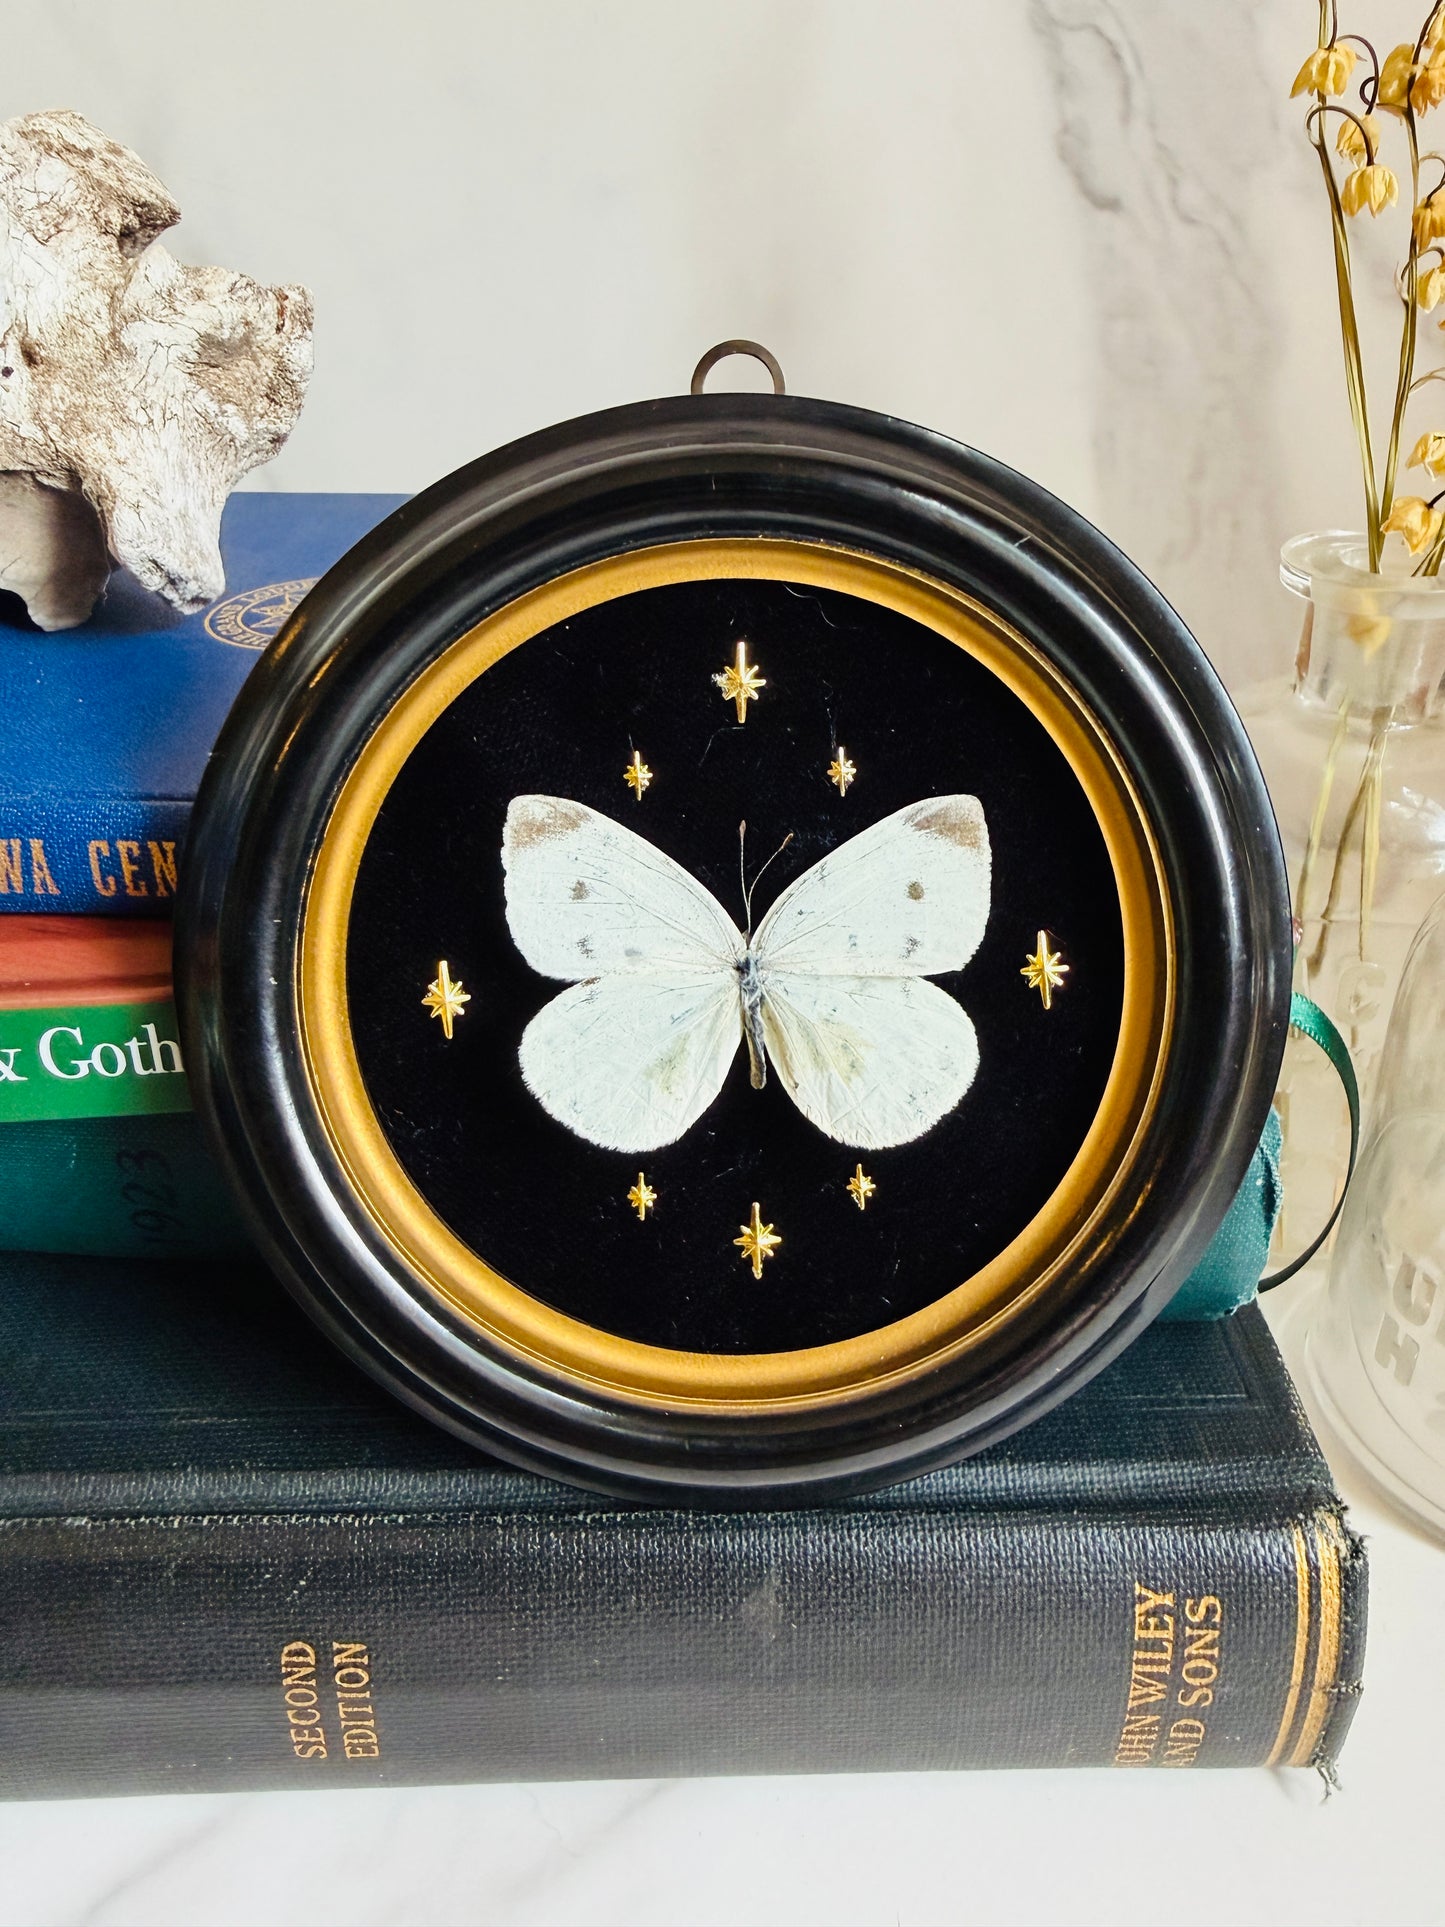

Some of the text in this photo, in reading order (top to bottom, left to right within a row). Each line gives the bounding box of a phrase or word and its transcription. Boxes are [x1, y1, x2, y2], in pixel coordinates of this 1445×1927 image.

[87, 839, 178, 897] CEN
[38, 1022, 185, 1080] Goth
[281, 1640, 328, 1759] SECOND
[332, 1640, 380, 1759] EDITION
[1113, 1581, 1175, 1767] OHN WILEY
[1177, 1595, 1223, 1708] SONS
